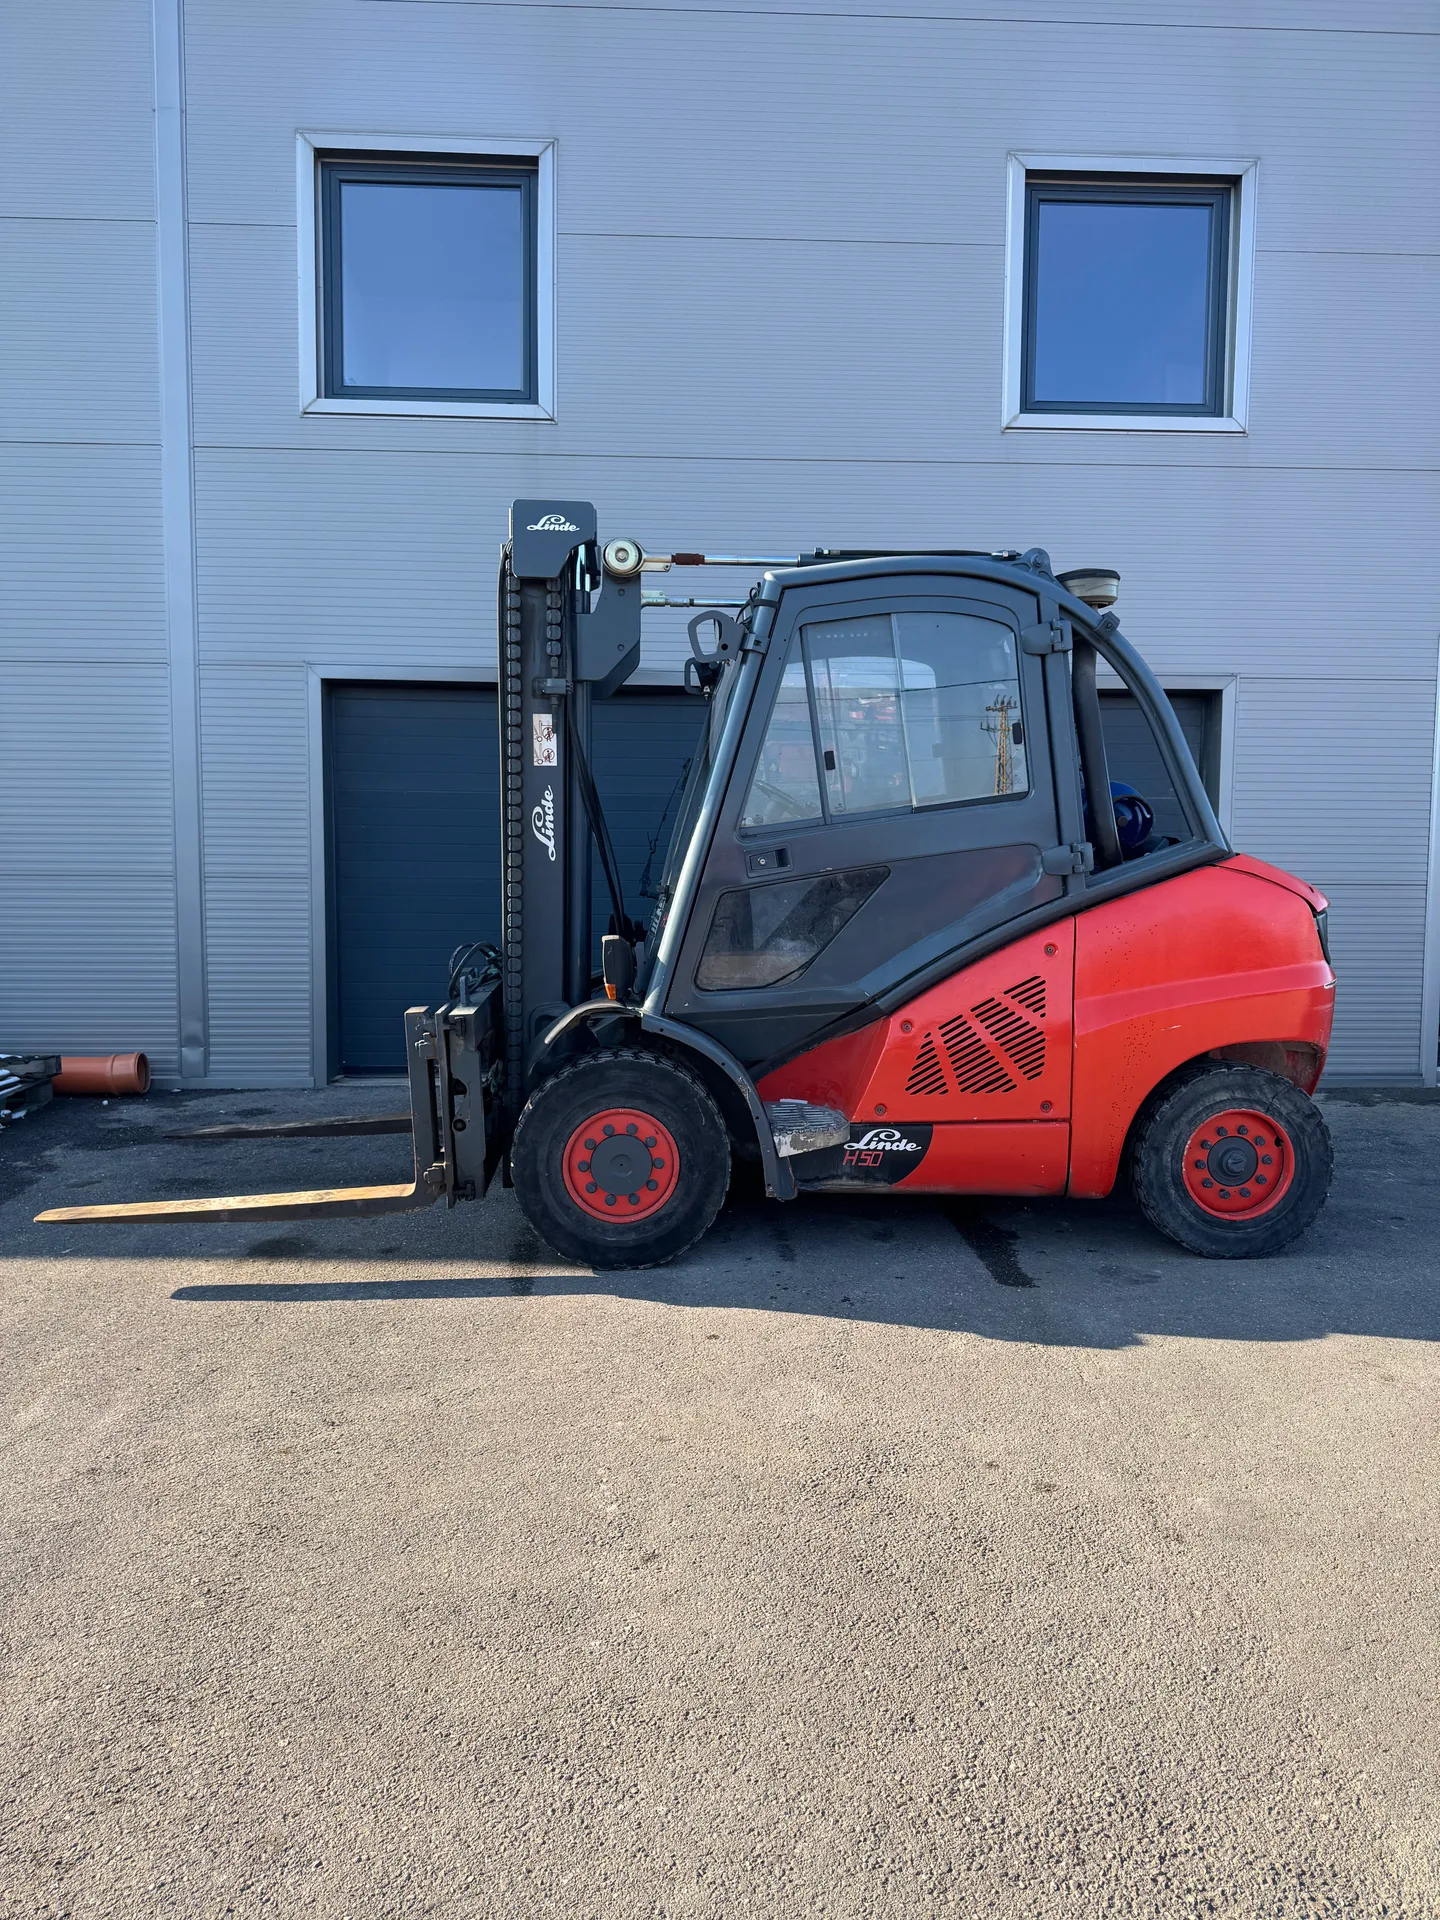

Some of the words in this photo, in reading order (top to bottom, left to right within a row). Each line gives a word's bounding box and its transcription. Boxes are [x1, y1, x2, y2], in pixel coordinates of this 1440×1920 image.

[526, 514, 580, 531] Linde
[532, 785, 556, 861] Linde
[843, 1128, 921, 1151] Linde
